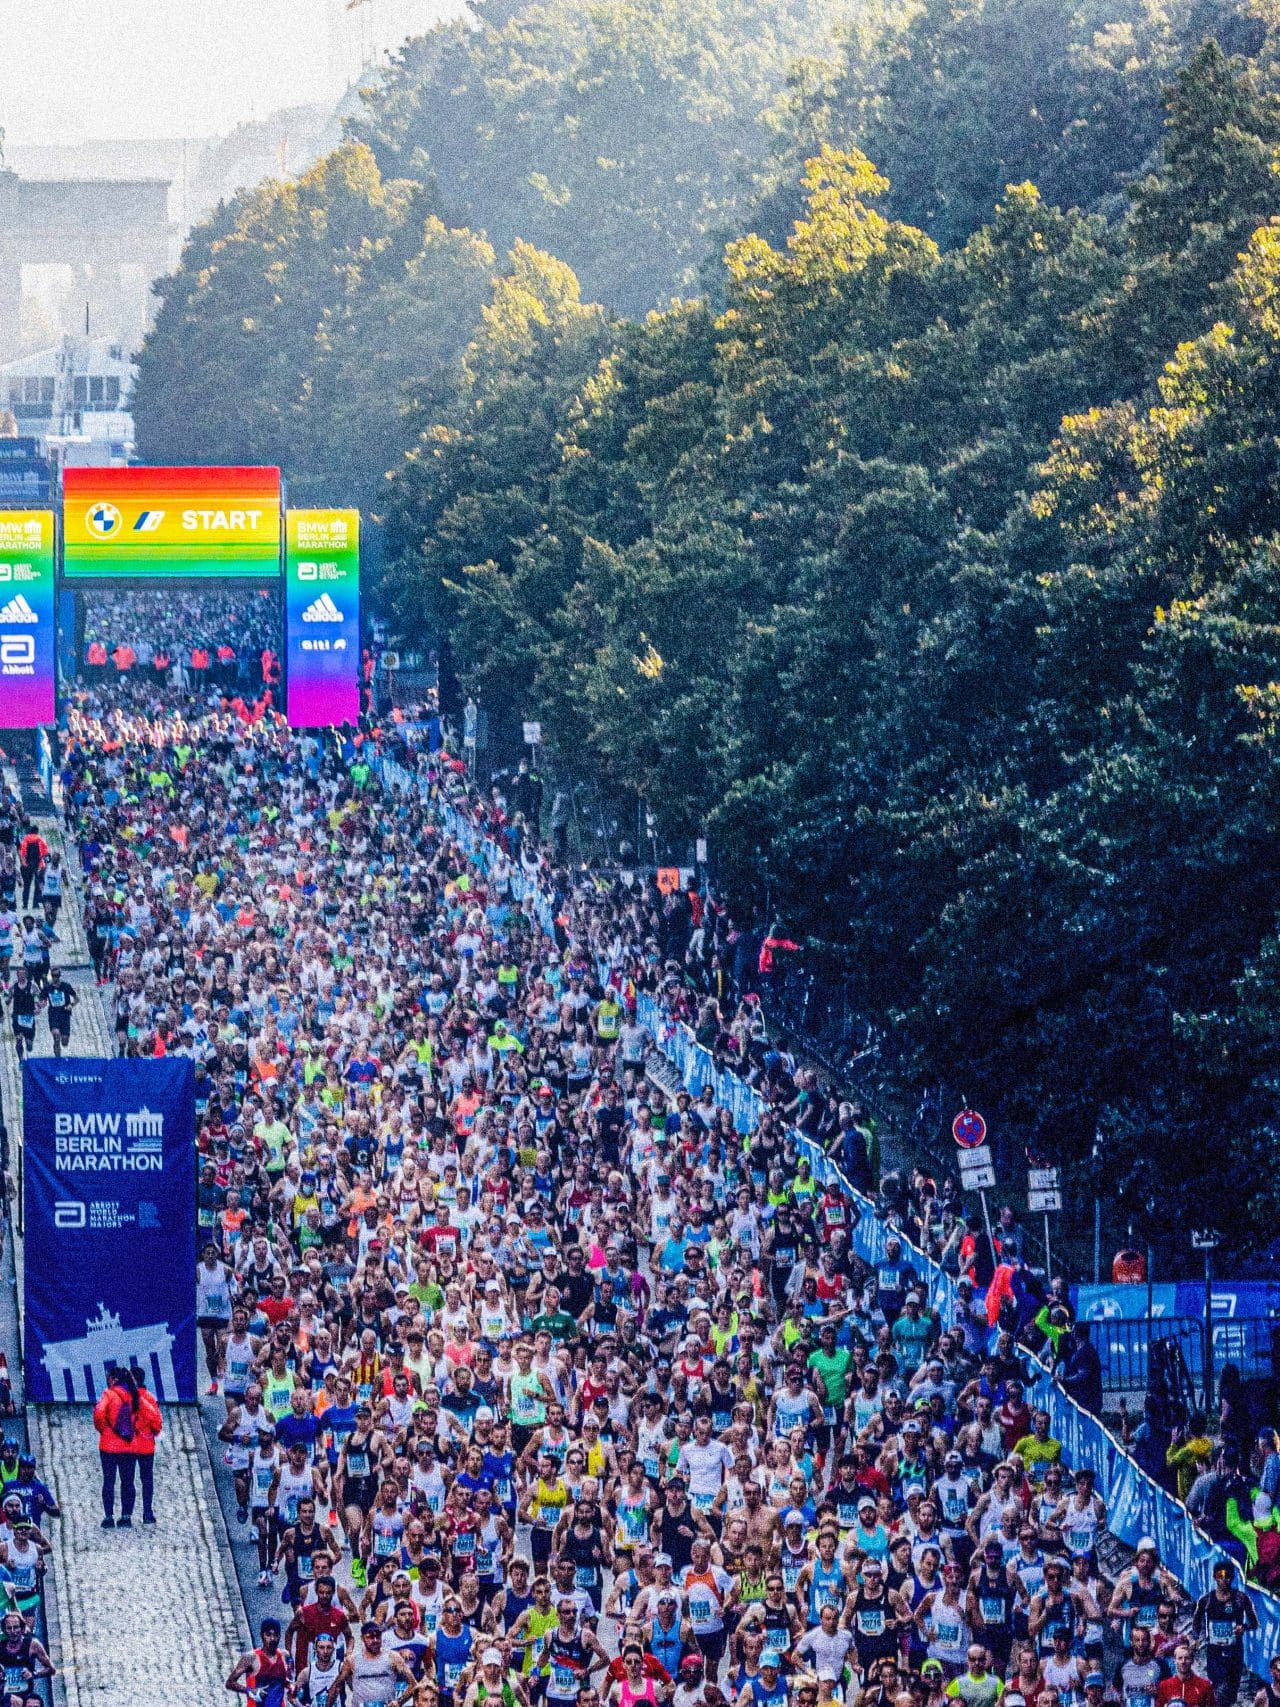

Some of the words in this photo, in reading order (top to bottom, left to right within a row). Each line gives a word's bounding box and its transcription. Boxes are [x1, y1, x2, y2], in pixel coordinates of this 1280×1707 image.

[182, 510, 263, 530] START
[298, 521, 328, 532] BMW
[298, 541, 347, 549] MARATHON
[55, 1112, 121, 1135] BMW
[55, 1136, 122, 1153] BERLIN
[55, 1154, 163, 1171] MARATHON
